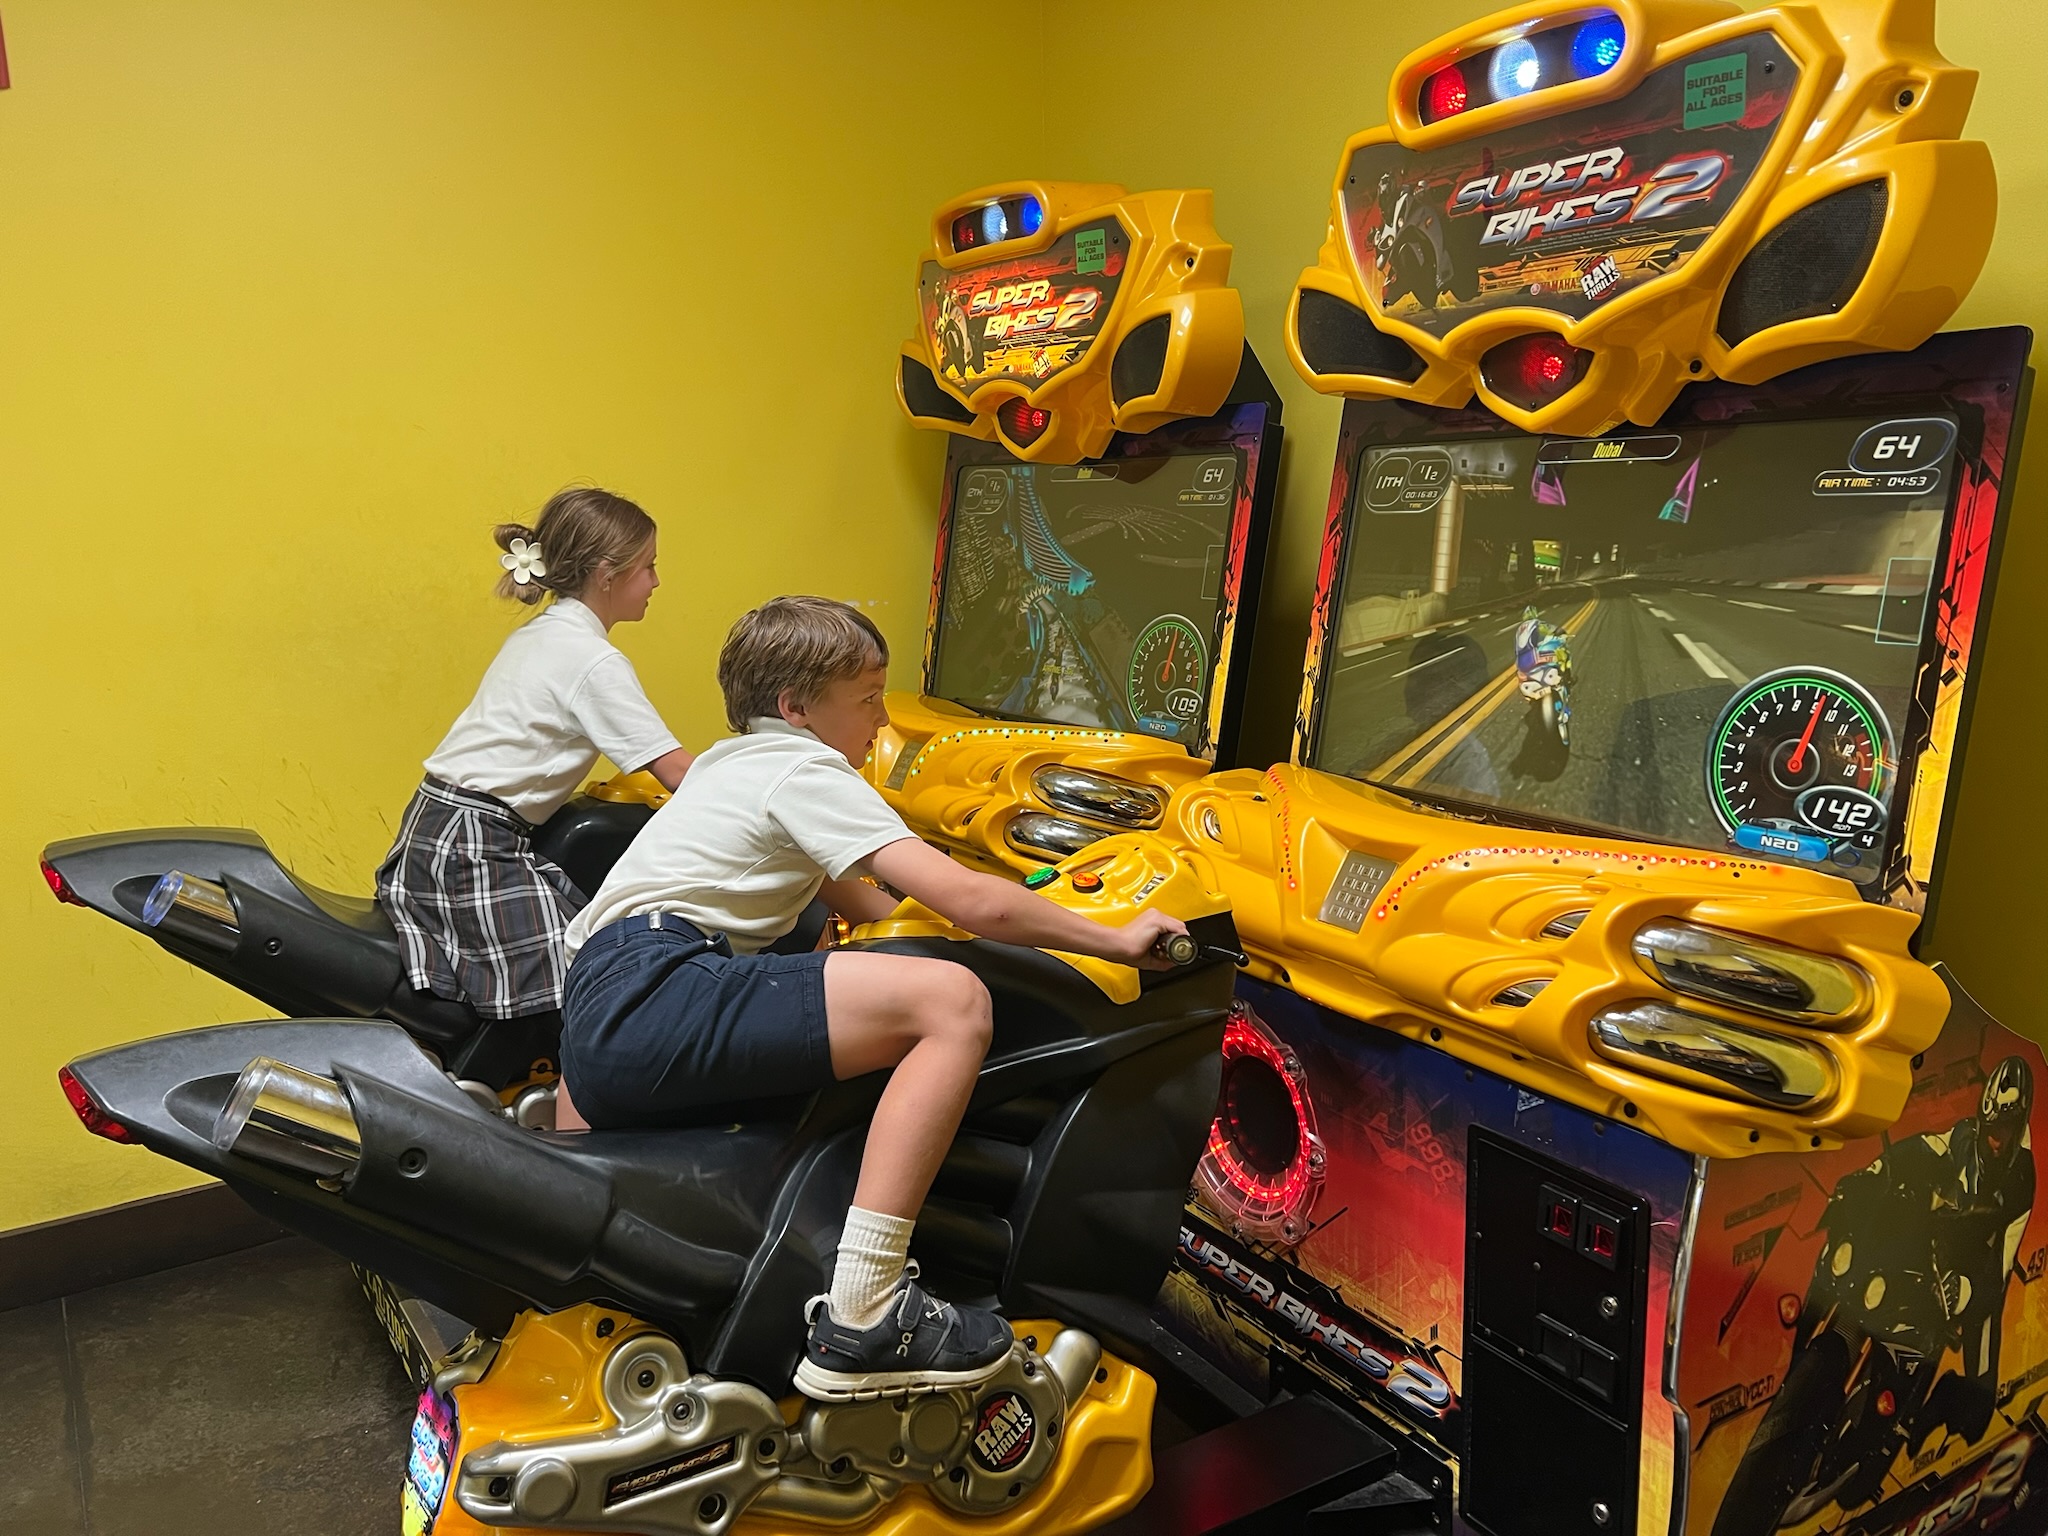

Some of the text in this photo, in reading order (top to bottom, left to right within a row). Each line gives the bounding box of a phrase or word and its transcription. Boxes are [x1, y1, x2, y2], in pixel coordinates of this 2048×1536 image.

[1687, 69, 1743, 90] SUITABLE
[1702, 85, 1726, 98] FOR
[1685, 93, 1743, 113] ALL AGES
[1451, 147, 1625, 209] SUPER
[1479, 186, 1640, 246] BIKES
[1630, 155, 1725, 224] 2
[1077, 239, 1104, 249] SUITABLE
[1085, 247, 1096, 255] FOR
[1580, 255, 1617, 293] RAW
[1585, 269, 1621, 300] THRILLS
[970, 280, 1050, 315] SUPER
[983, 291, 1099, 340] BIKES 2
[1592, 441, 1626, 459] Dubai
[1872, 434, 1922, 460] 64
[1203, 467, 1225, 483] 64
[1818, 478, 1841, 489] AIR
[1887, 476, 1928, 488] 04:53
[1171, 696, 1199, 713] 109
[1775, 703, 1784, 715] 7
[1791, 700, 1802, 712] 8
[1758, 712, 1769, 723] 6
[1824, 709, 1839, 722] 10
[1746, 725, 1757, 737] 5
[1837, 724, 1849, 736] 11
[1737, 743, 1746, 755] 4
[1842, 744, 1856, 757] 12
[1733, 762, 1744, 774] 3
[1843, 765, 1857, 777] 13
[1738, 781, 1748, 793] 2
[1748, 798, 1756, 810] 1
[1811, 797, 1873, 828] 142
[1861, 834, 1874, 847] 4
[1274, 1291, 1395, 1379] BIKES
[1386, 1358, 1452, 1419] 2
[974, 1394, 1024, 1458] RAW
[986, 1412, 1033, 1467] THRILLS
